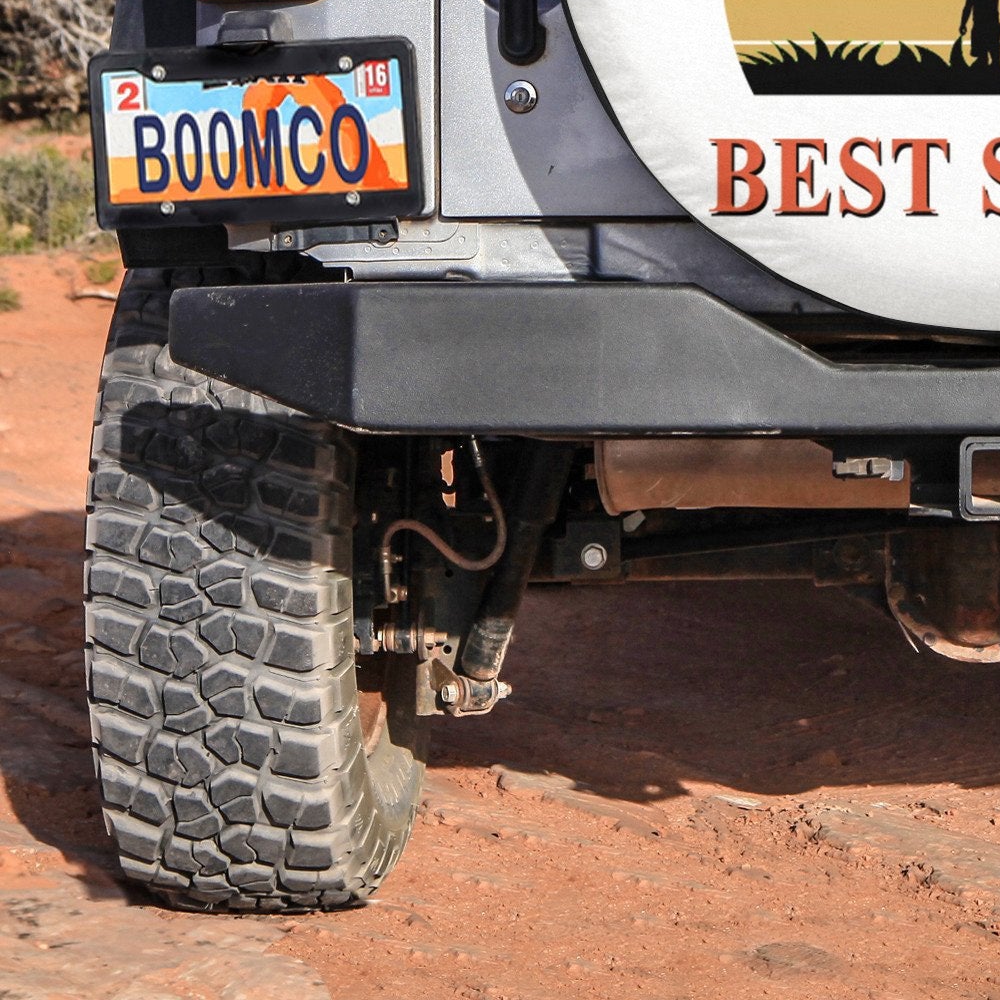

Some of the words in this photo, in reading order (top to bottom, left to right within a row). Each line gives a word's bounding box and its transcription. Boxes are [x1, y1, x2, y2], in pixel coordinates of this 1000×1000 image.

[365, 63, 387, 87] 16
[117, 81, 140, 111] 2
[708, 137, 951, 218] BEST
